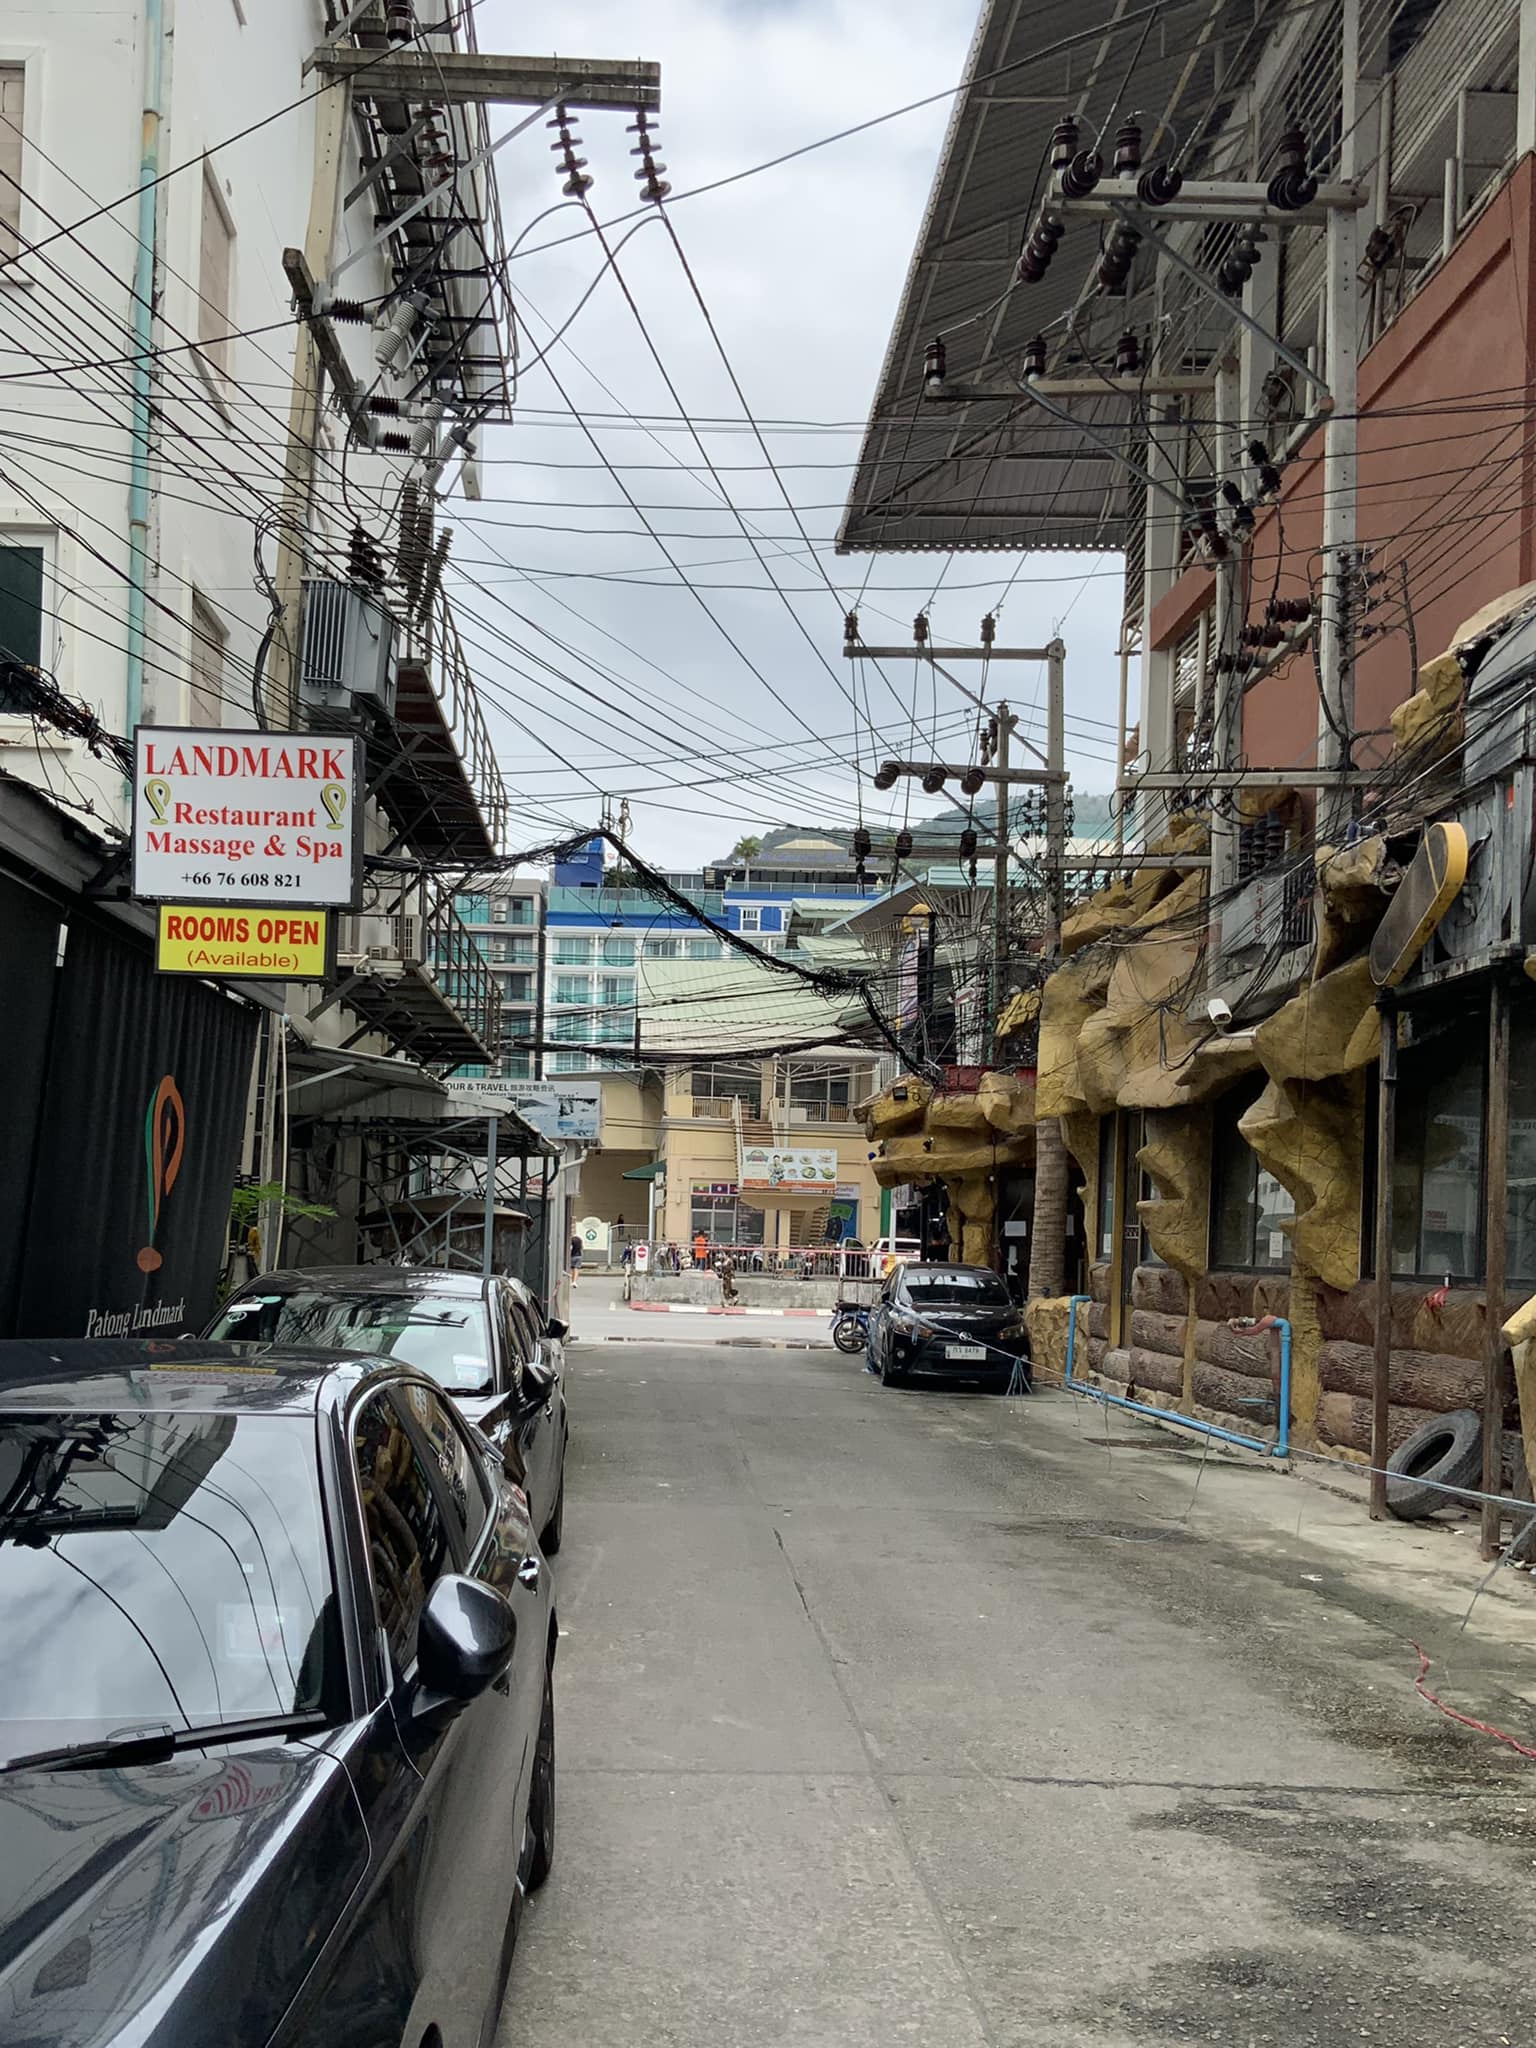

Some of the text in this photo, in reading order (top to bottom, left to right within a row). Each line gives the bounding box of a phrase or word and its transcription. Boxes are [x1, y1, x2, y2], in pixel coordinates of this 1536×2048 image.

[144, 743, 346, 779] LANDMARK
[174, 802, 317, 827] Restaurant
[144, 831, 344, 864] Massage & Spa
[181, 872, 302, 888] +66 76 608 821
[167, 915, 319, 945] ROOMS OPEN
[186, 949, 299, 971] (Available)
[447, 1083, 465, 1091] OUR
[476, 1083, 509, 1092] TRAVEL
[84, 1309, 130, 1339] Patong
